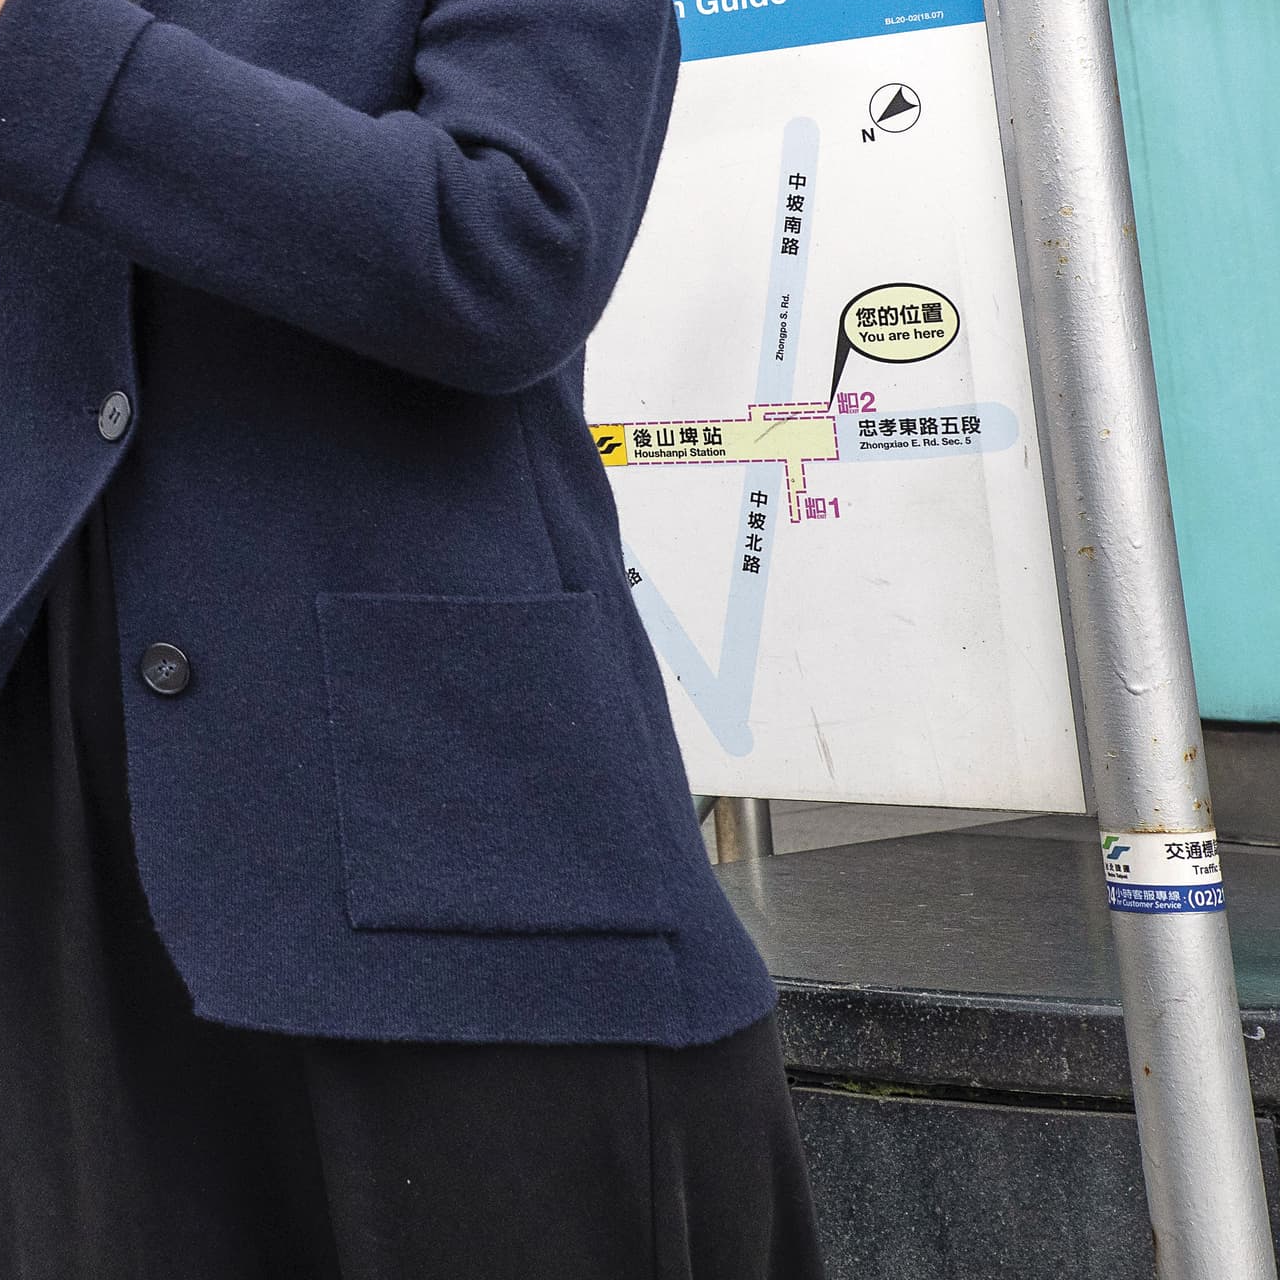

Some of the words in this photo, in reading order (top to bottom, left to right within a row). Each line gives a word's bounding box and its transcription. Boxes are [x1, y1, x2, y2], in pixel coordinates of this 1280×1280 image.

[861, 127, 876, 143] N
[780, 172, 807, 256] 中坡南路
[780, 293, 790, 309] Rd.
[779, 310, 789, 320] S.
[856, 302, 944, 328] 您的位置
[775, 321, 788, 362] Zhongpo
[858, 331, 885, 343] You
[888, 331, 911, 341] are
[913, 328, 945, 340] here
[858, 416, 981, 437] 忠孝東路五段
[632, 426, 723, 448] 後山埤站
[859, 440, 909, 451] Zhongxiao
[911, 439, 921, 448] E.
[923, 437, 940, 447] Rd.
[941, 437, 963, 446] Sec.
[965, 435, 972, 445] 5
[634, 447, 687, 459] Houshanpi
[689, 447, 727, 457] Station
[742, 490, 769, 574] 中坡北路
[1122, 899, 1153, 909] Customer
[1155, 901, 1182, 909] Service
